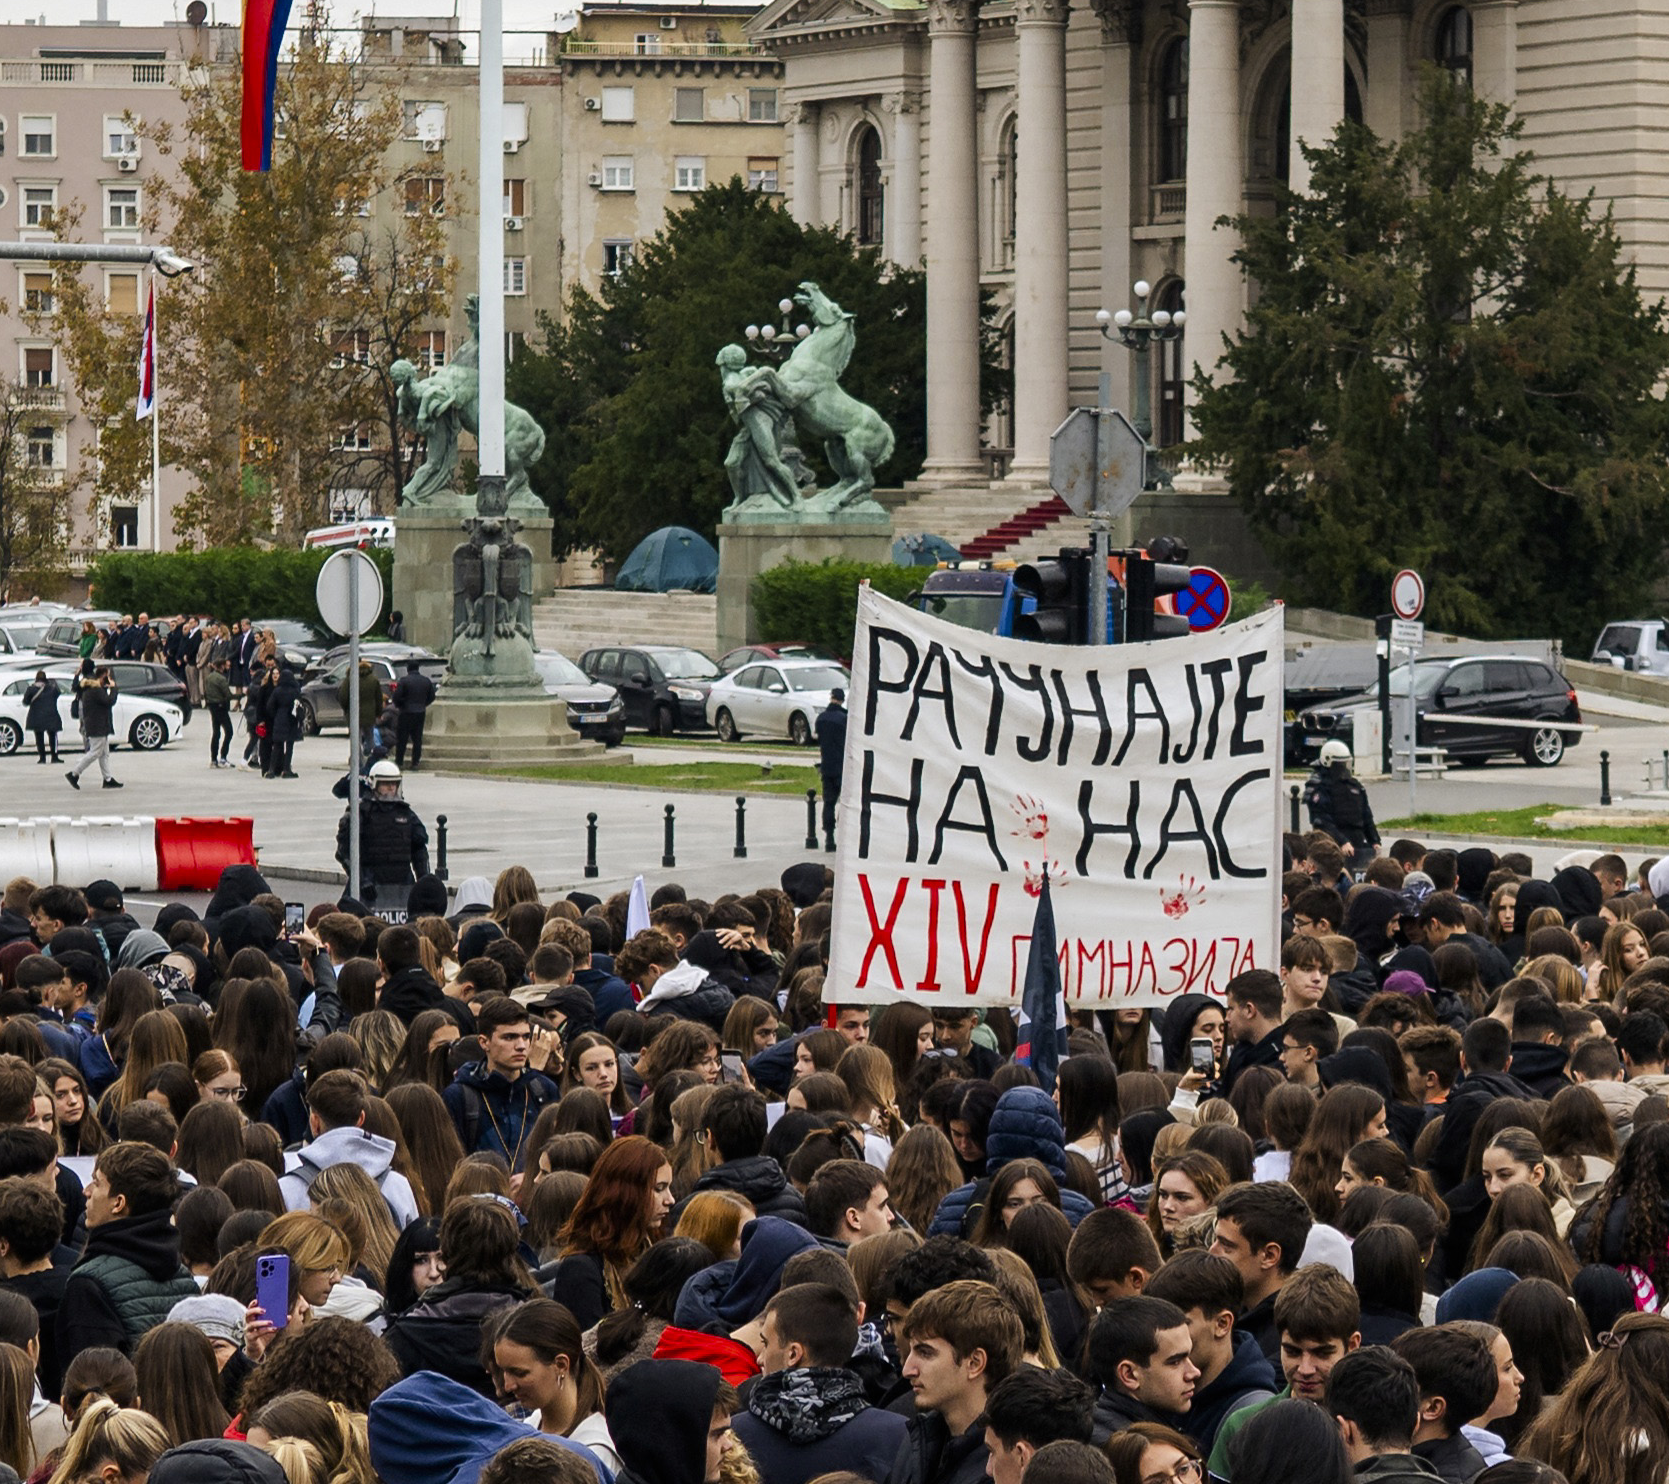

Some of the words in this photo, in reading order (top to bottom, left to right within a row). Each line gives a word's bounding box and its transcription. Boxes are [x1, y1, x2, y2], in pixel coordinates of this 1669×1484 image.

[863, 625, 1268, 767] РАЧУНАЈТЕ
[858, 749, 1009, 873] НА
[1074, 767, 1271, 881] НАС
[854, 873, 1001, 996] XIV
